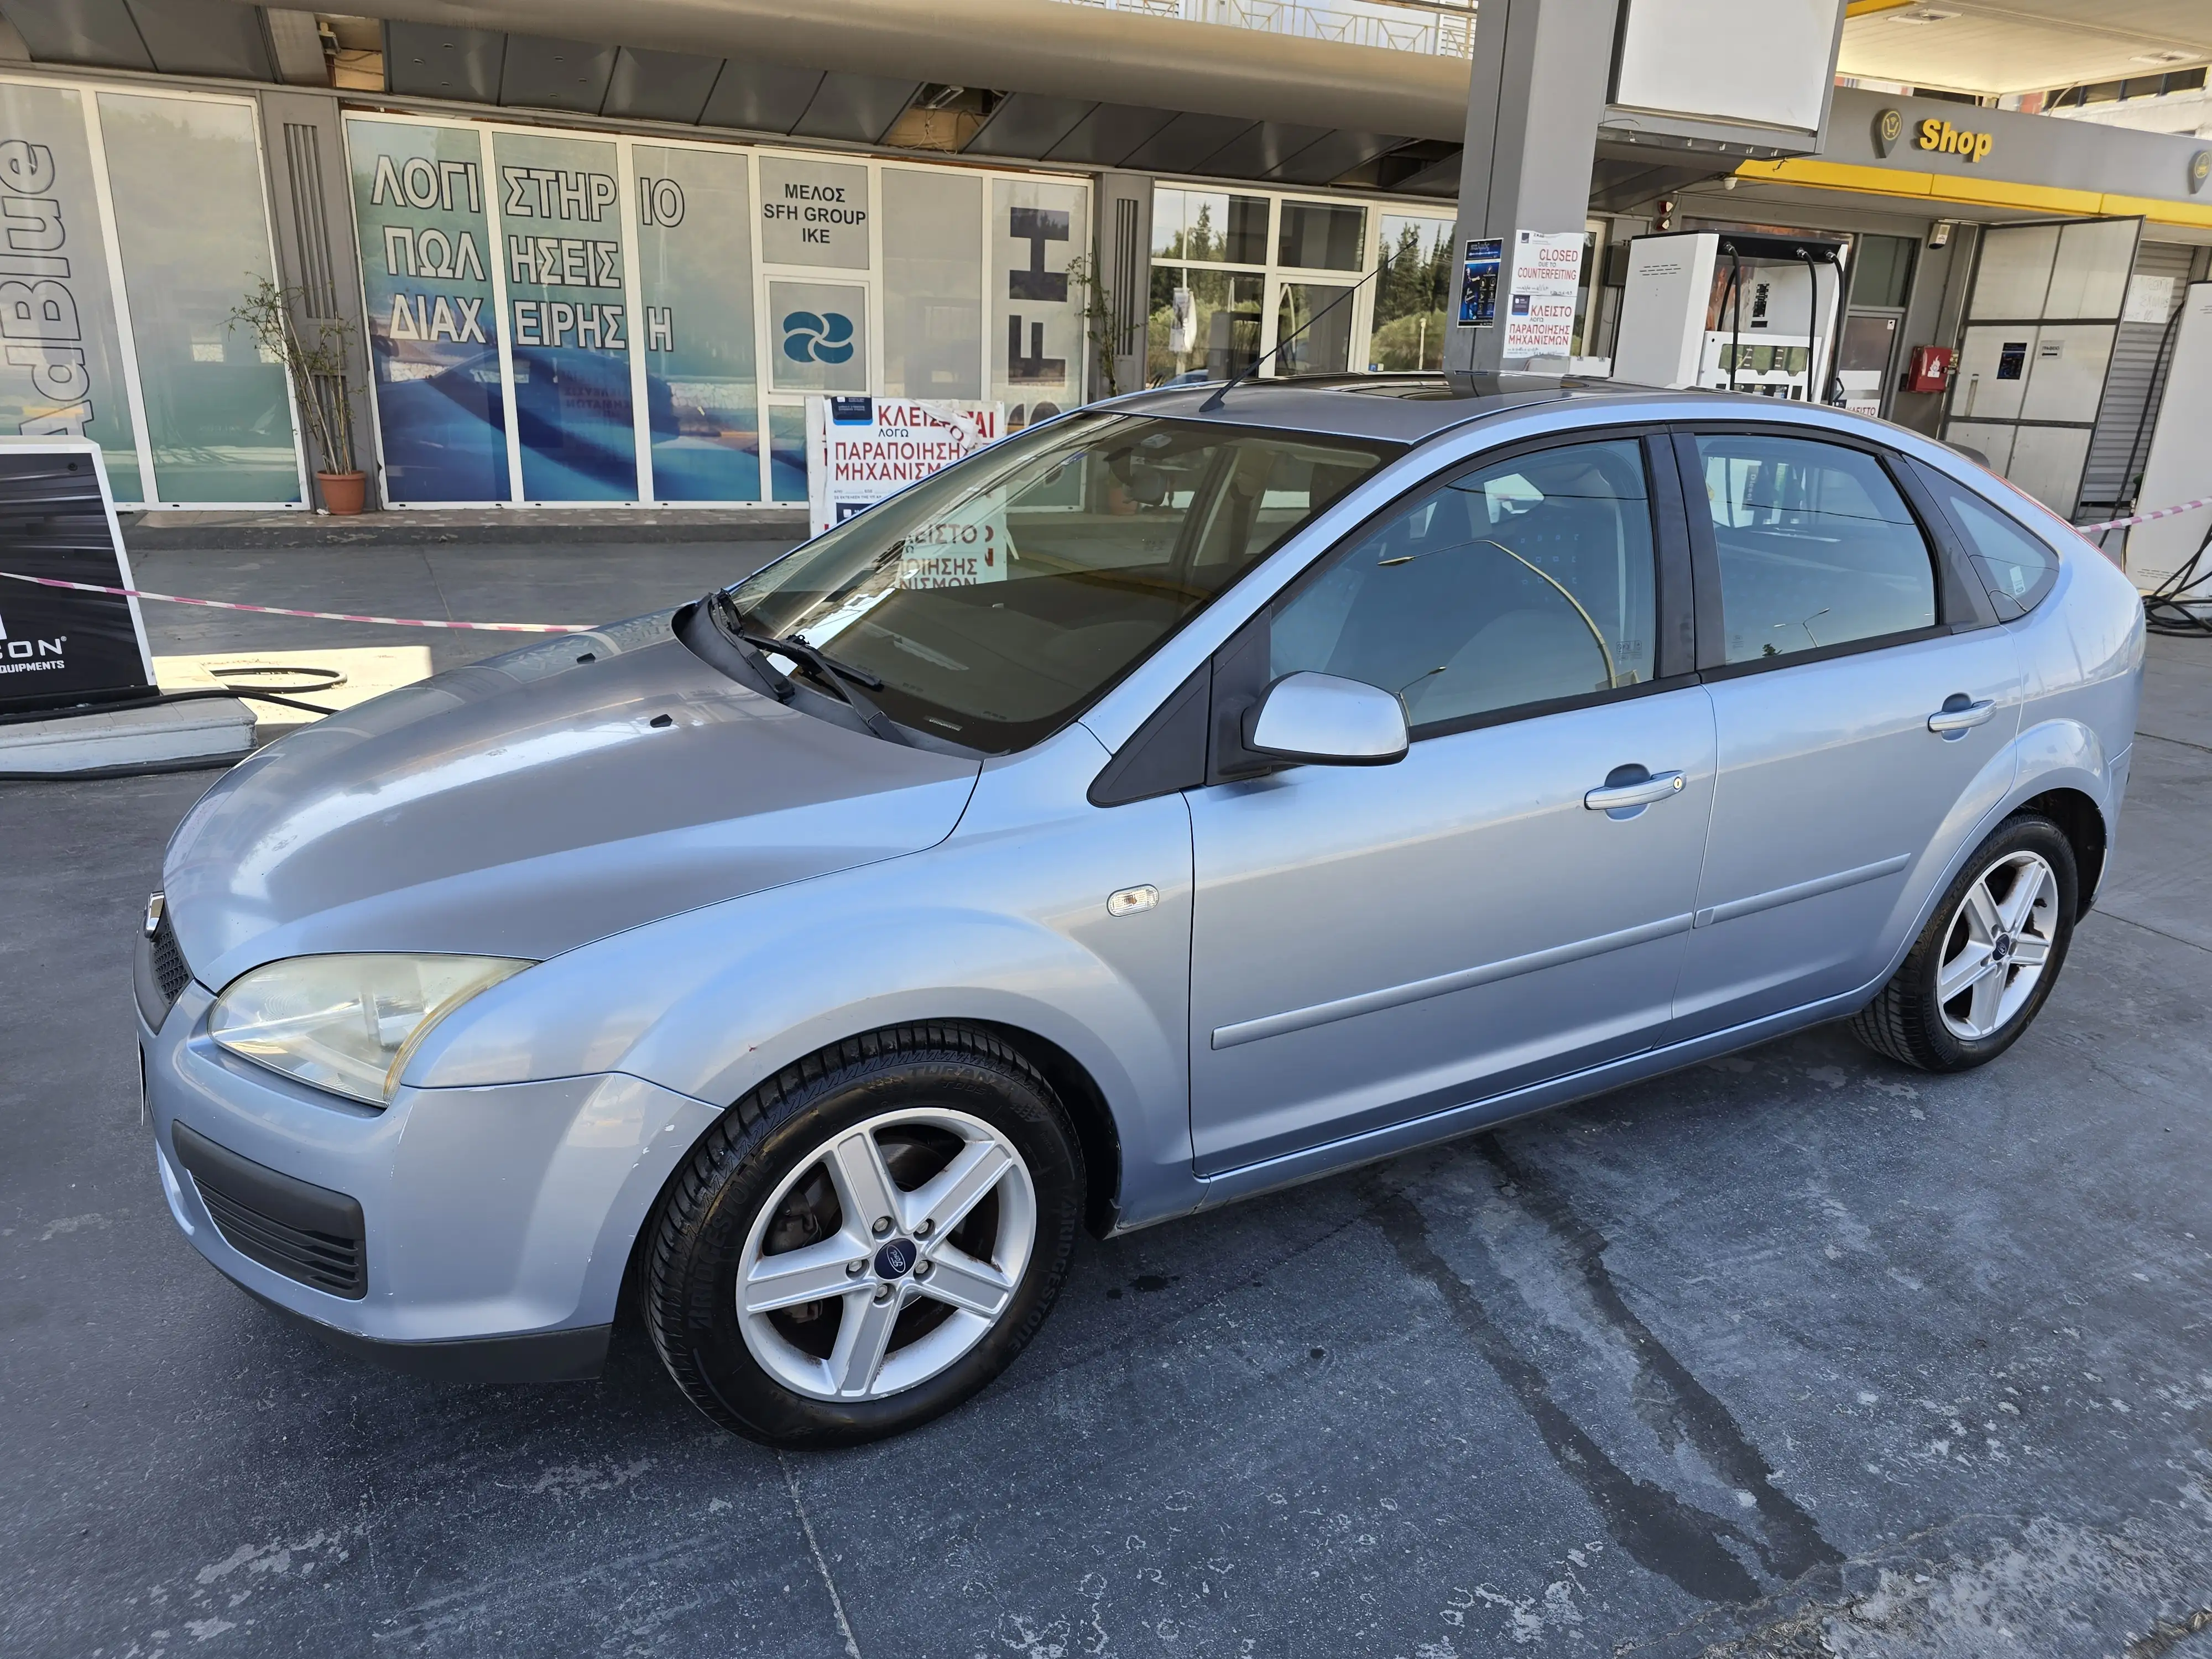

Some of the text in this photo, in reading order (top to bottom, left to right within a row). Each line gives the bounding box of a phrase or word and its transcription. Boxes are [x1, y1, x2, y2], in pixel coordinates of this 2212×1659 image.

[1920, 118, 1992, 163] Shop
[784, 183, 845, 203] ΜΕΛΟΣ
[763, 204, 867, 226] SFH GROUP
[1539, 249, 1578, 262] CLOSED
[1517, 267, 1577, 280] COUNTERFEITING
[1531, 305, 1572, 317] ΚΛΕΙΣΤΟ
[1509, 324, 1570, 335] ΠΑΡΑΠΟΙΗΣΗΣ
[1508, 335, 1569, 345] ΜΗΧΑΝΙΣΜΩΝ
[878, 429, 909, 437] ΛΟΓΩ
[890, 1250, 903, 1267] Ford
